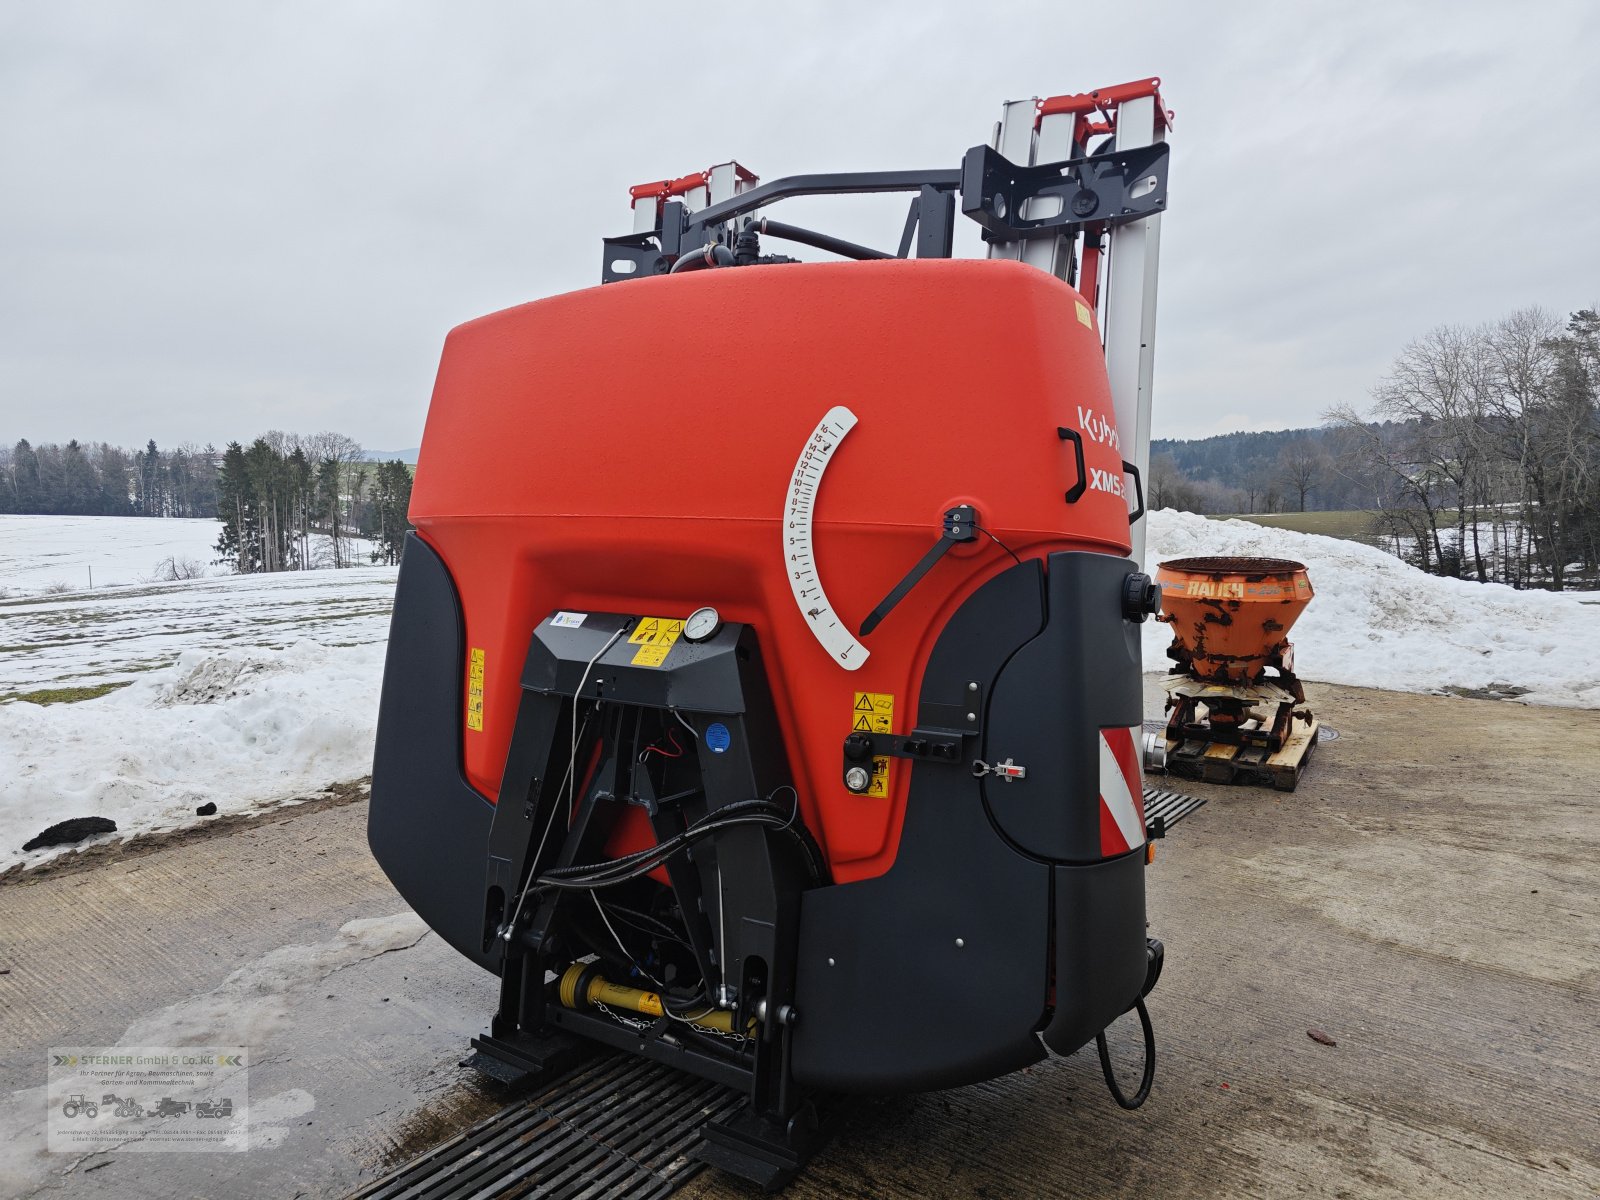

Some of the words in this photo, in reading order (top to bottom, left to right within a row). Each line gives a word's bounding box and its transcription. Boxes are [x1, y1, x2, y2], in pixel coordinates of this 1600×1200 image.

[820, 423, 828, 434] 16
[814, 433, 822, 443] 15
[808, 443, 816, 452] 14
[804, 452, 812, 460] 13
[800, 460, 808, 469] 12
[796, 469, 804, 478] 11
[794, 478, 802, 487] 10
[794, 488, 800, 496] 9
[792, 498, 798, 506] 8
[791, 508, 797, 516] 7
[789, 520, 795, 529] 6
[789, 537, 795, 545] 5
[791, 554, 797, 562] 4
[794, 571, 801, 580] 3
[800, 590, 807, 598] 2
